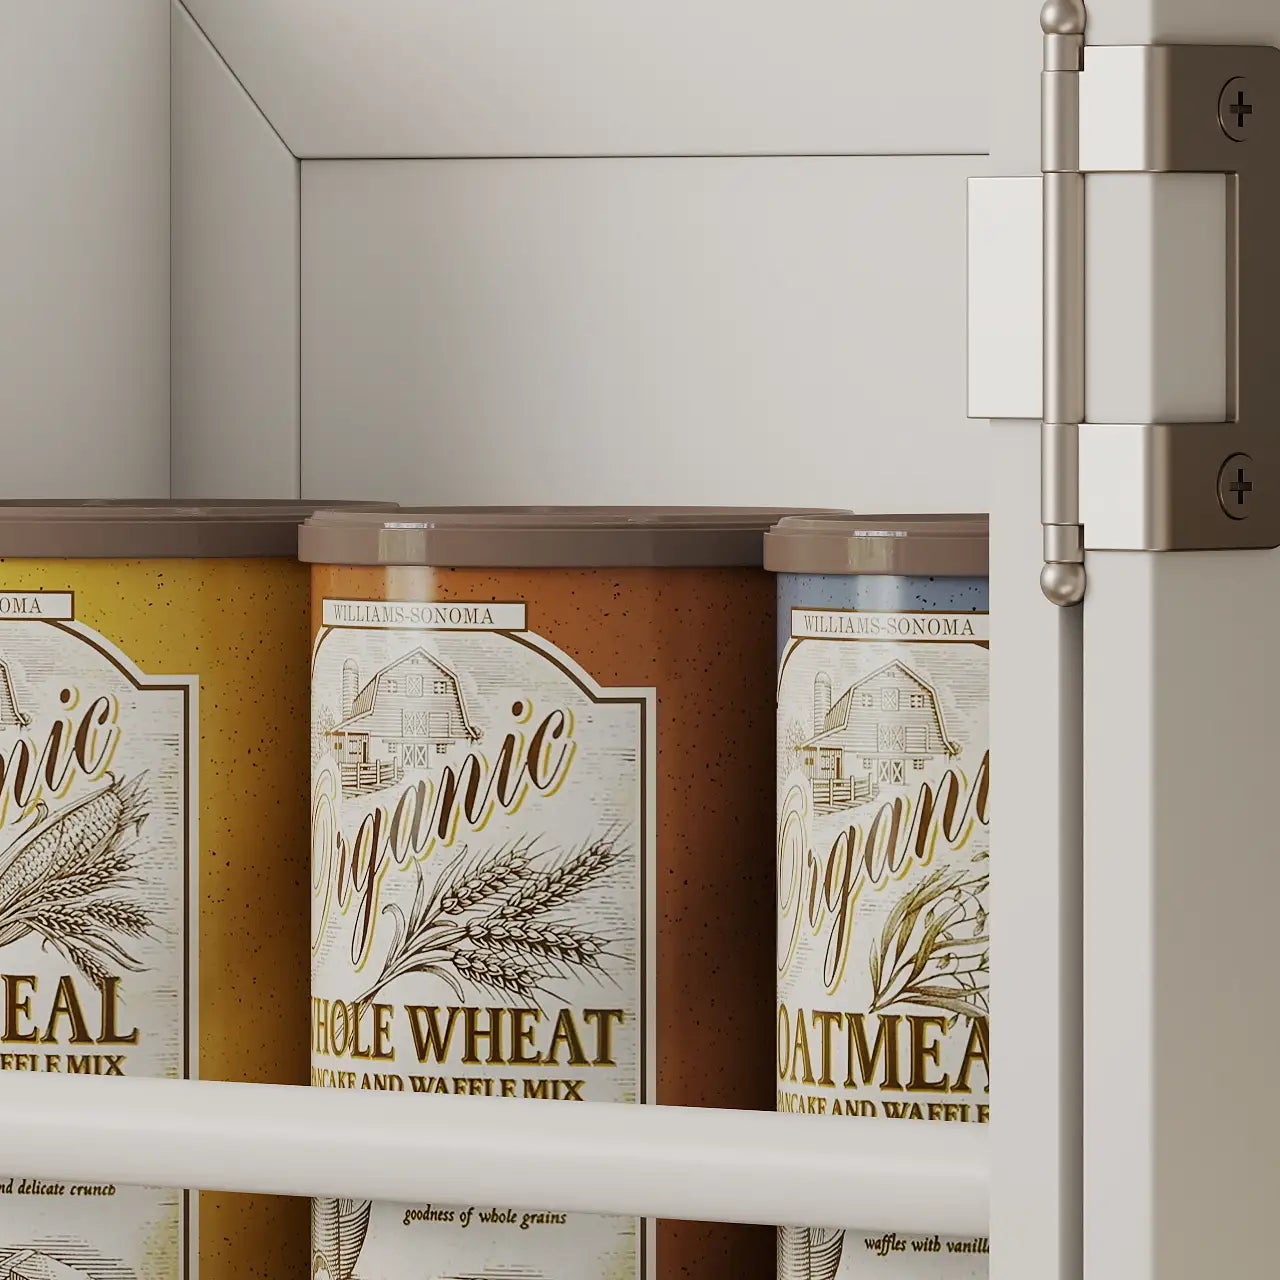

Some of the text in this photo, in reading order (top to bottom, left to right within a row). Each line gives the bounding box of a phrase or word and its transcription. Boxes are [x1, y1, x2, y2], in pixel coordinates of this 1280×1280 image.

[333, 604, 494, 625] WILLIAMS-SONOMA
[804, 615, 975, 637] WILLIAMS-SONOMA
[311, 996, 625, 1067] HOLE WHEAT
[66, 1055, 128, 1076] MIX
[361, 1072, 405, 1091] AND
[522, 1079, 587, 1101] MIX
[832, 1098, 878, 1117] AND
[17, 1179, 65, 1196] delicate
[403, 1204, 567, 1230] goodness of whole grains
[864, 1232, 989, 1256] waffles with vanill
